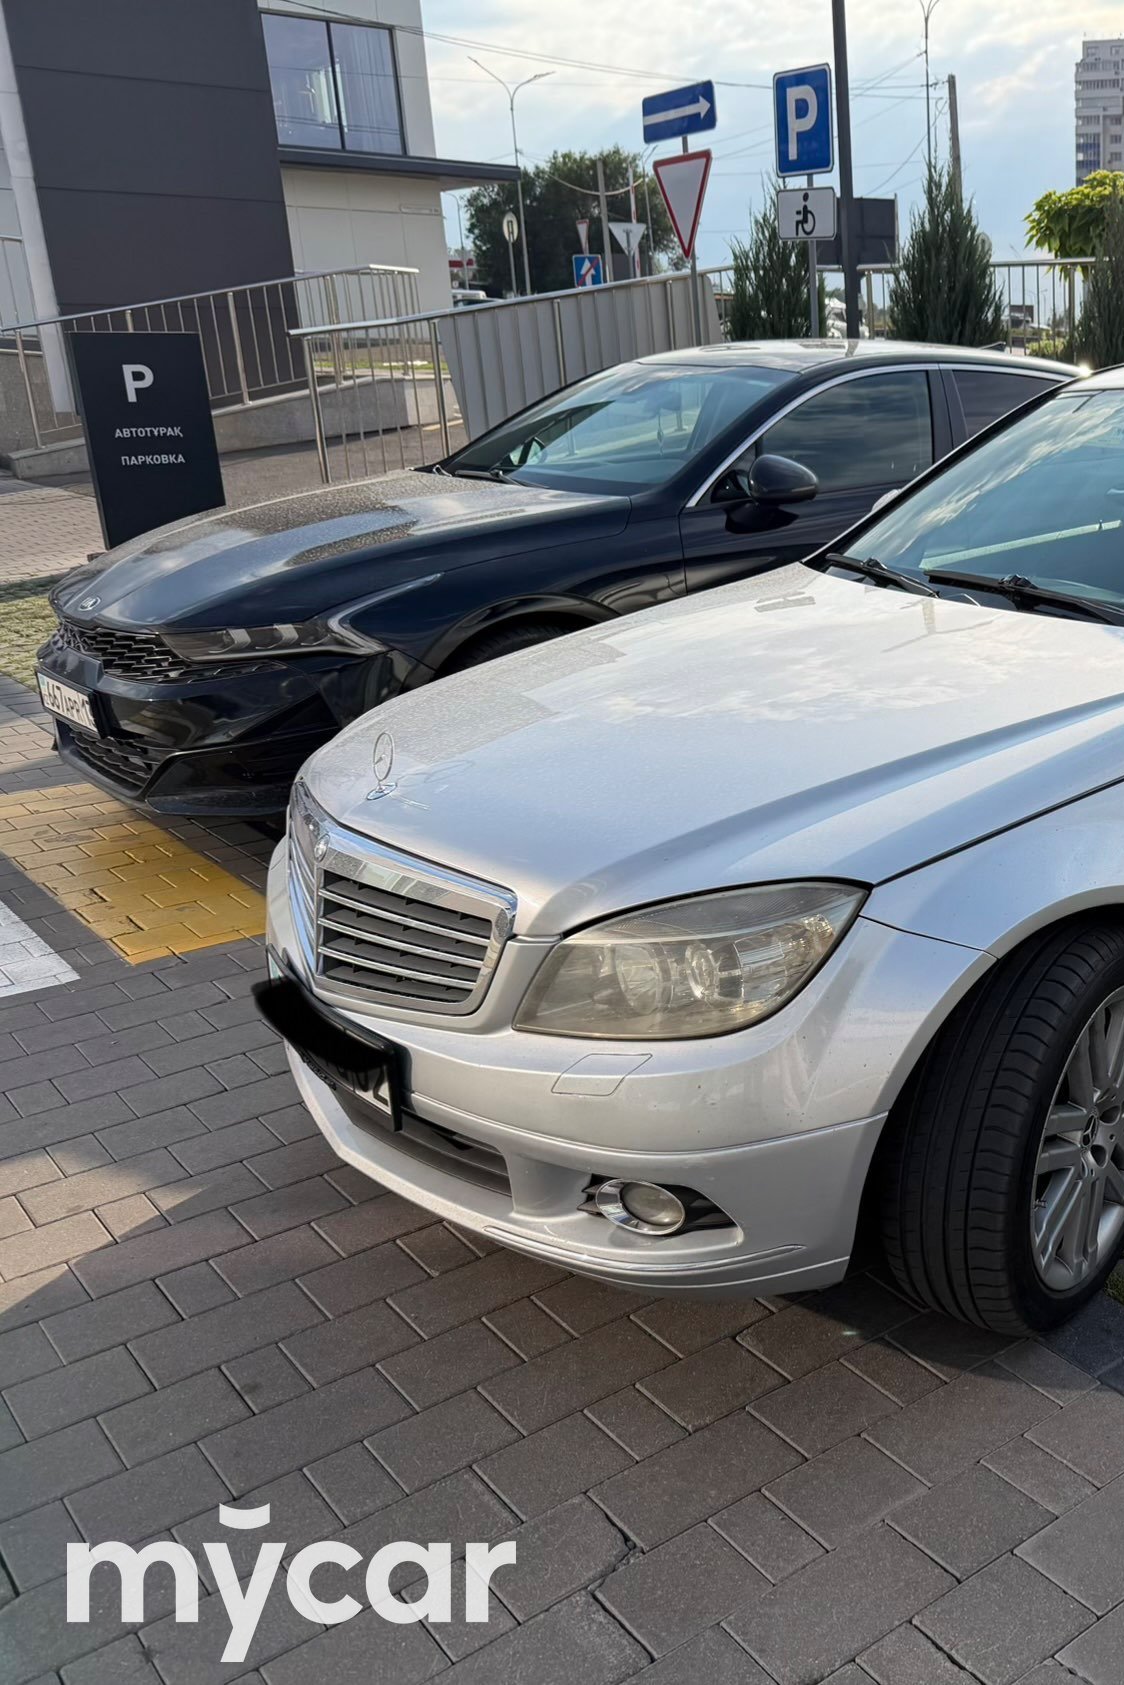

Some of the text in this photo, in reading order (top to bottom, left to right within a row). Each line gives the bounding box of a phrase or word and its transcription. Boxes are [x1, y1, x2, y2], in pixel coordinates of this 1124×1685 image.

[786, 84, 818, 161] P
[122, 364, 154, 403] P
[121, 453, 186, 466] ПАРКОВКА
